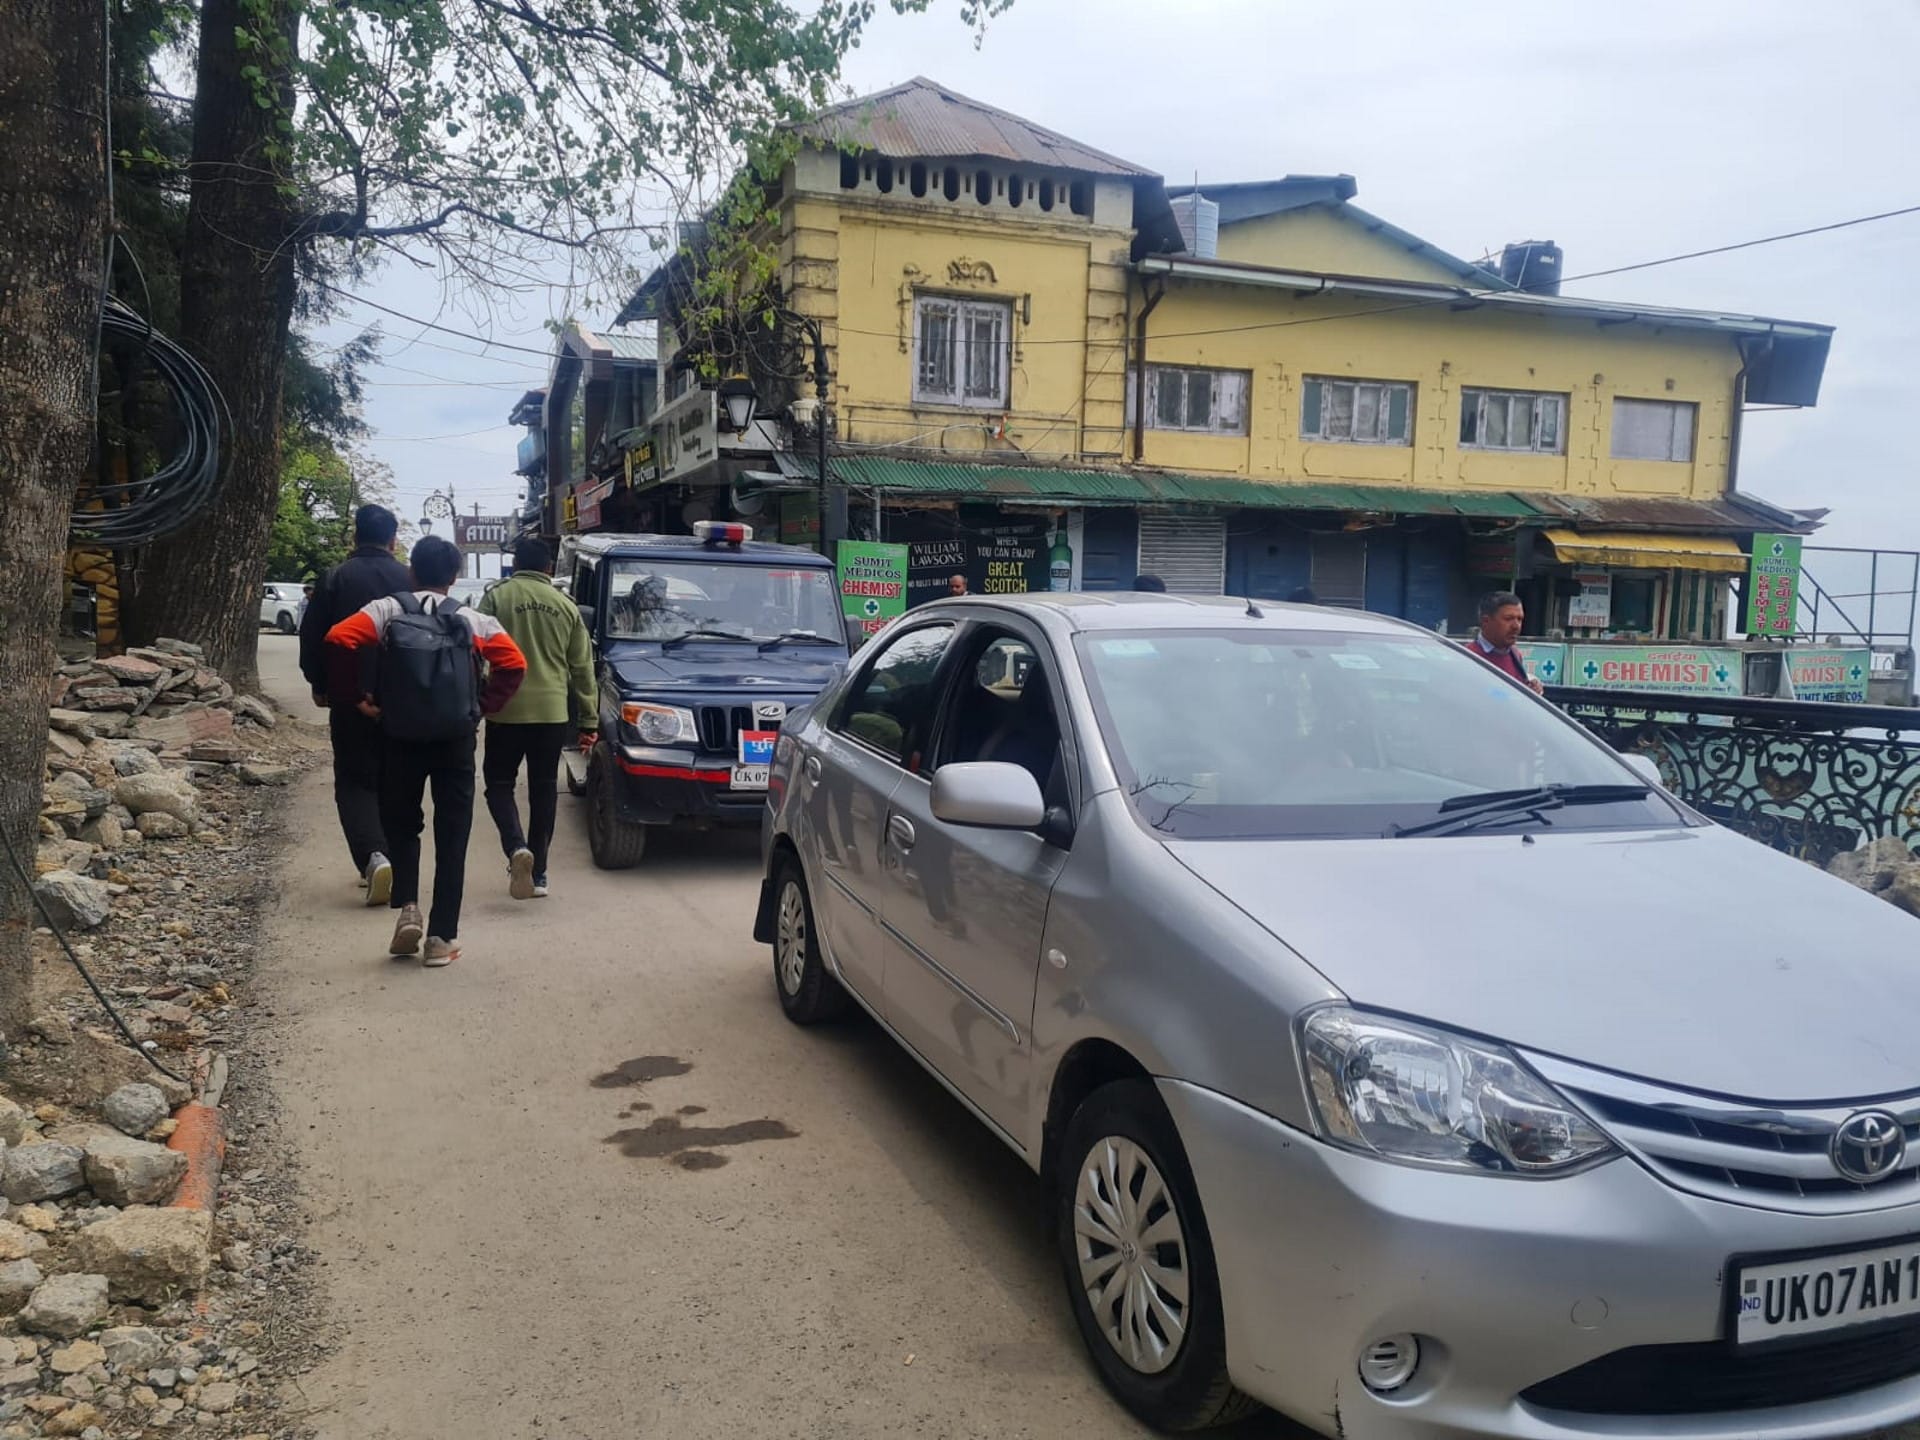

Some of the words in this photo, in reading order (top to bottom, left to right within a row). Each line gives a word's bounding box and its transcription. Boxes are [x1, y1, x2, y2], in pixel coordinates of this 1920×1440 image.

[996, 536, 1018, 546] WHEN
[913, 543, 960, 555] WILLIAM
[977, 546, 992, 558] YOU
[994, 547, 1009, 558] CAN
[1011, 548, 1036, 560] ENJOY
[854, 556, 893, 567] SUMIT
[911, 553, 964, 567] LAWSON'S
[845, 567, 901, 578] MEDICOS
[988, 561, 1024, 577] GREAT
[842, 579, 902, 598] CHEMIST
[984, 578, 1028, 593] SCOTCH
[1602, 661, 1711, 683] CHEMIST
[734, 770, 752, 783] UK
[755, 771, 768, 782] 07
